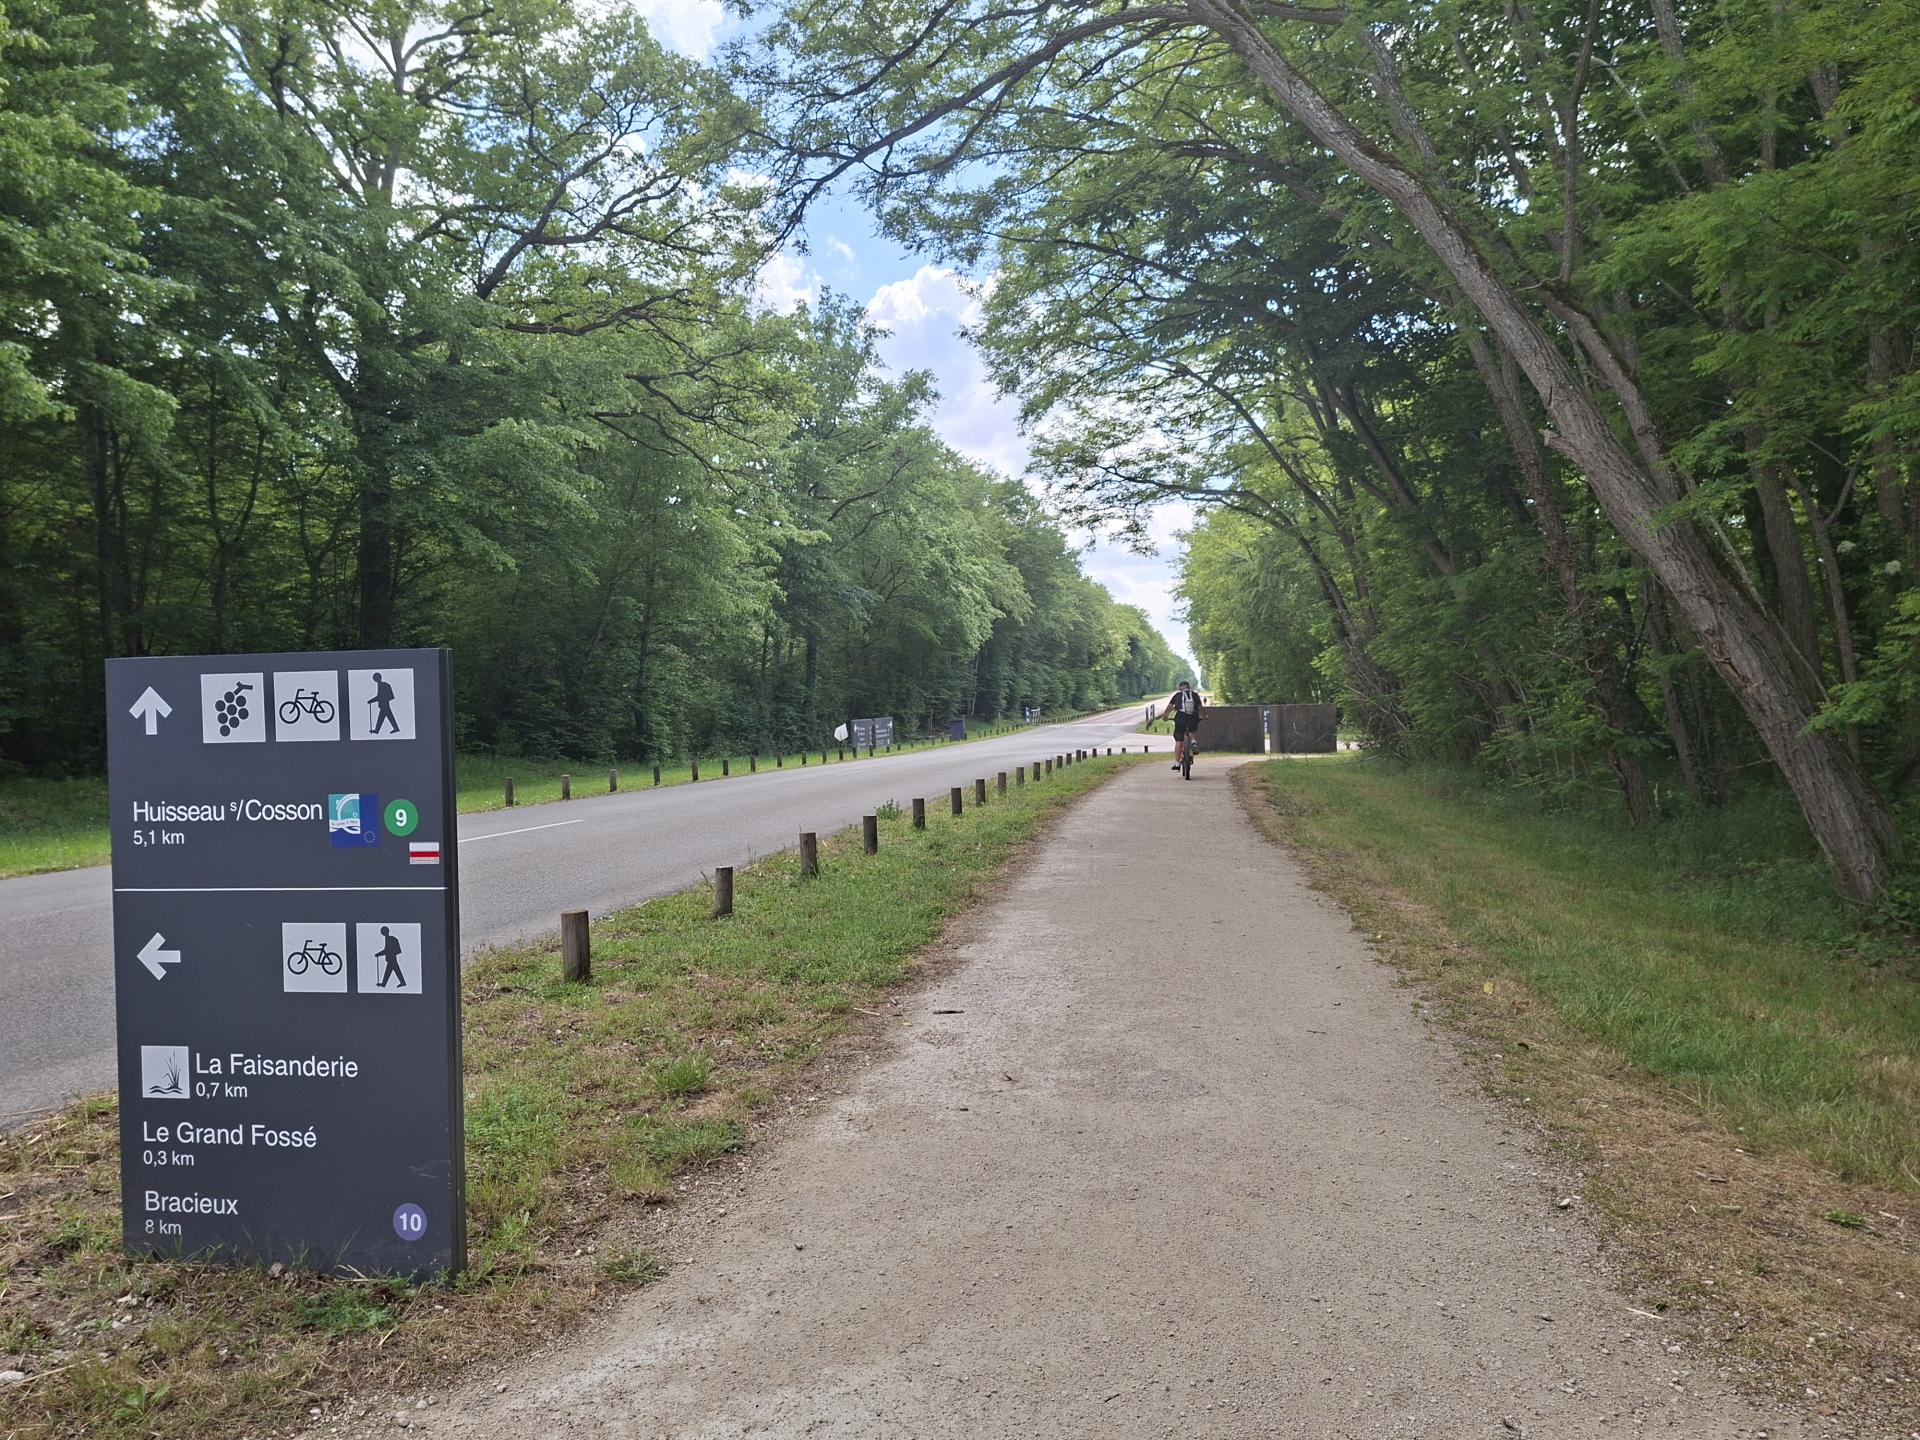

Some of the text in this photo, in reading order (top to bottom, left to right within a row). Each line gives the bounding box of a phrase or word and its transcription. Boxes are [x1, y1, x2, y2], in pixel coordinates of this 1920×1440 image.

[133, 800, 225, 822] Huisseau
[395, 809, 407, 827] 9
[133, 828, 185, 848] 5,1 km
[195, 1052, 359, 1078] La Faisanderie
[195, 1081, 248, 1099] 0,7 km
[143, 1120, 317, 1148] Le Grand Fossé
[143, 1149, 195, 1167] 0,3 km
[145, 1190, 239, 1215] Bracieux
[145, 1219, 182, 1235] 8 km
[398, 1212, 422, 1232] 10
